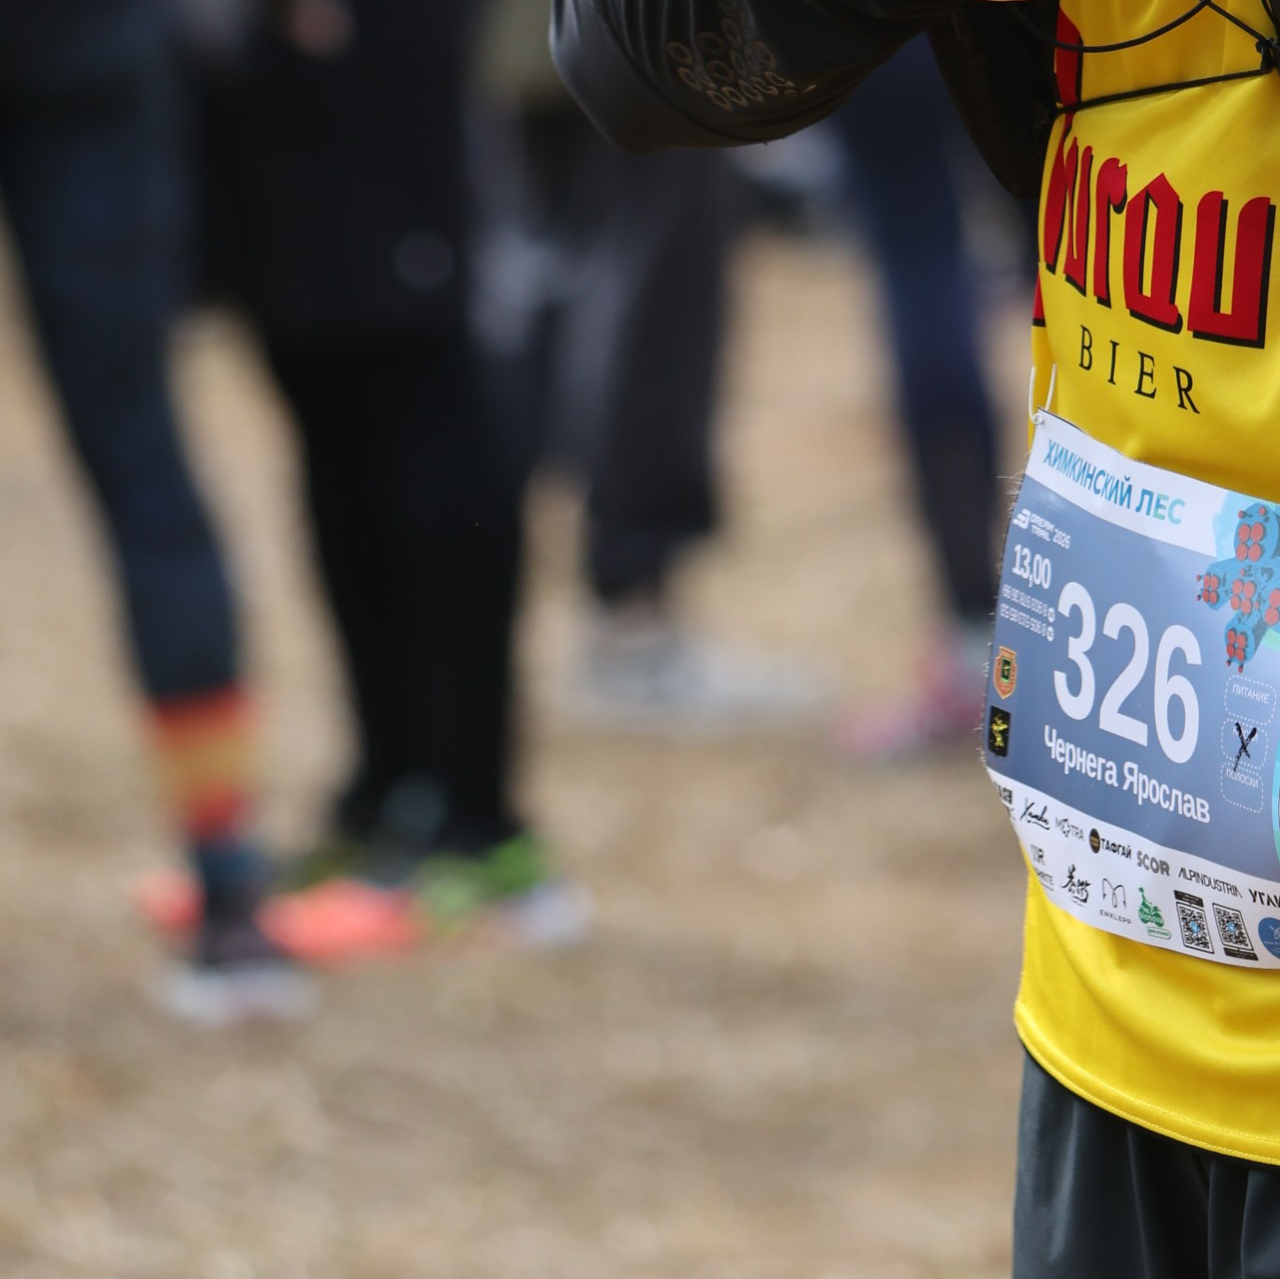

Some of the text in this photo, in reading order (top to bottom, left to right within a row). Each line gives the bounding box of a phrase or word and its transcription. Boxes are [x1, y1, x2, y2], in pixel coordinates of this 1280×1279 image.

[1078, 324, 1200, 415] BIER
[1043, 439, 1186, 526] ХИМКИНСКИЙ ЛЕС
[1012, 544, 1052, 589] 13,00
[1053, 581, 1202, 764] 326
[1232, 684, 1270, 704] ПИТАНИЕ
[1044, 725, 1118, 787] Чернега
[1122, 761, 1211, 824] Ярослав
[1137, 850, 1170, 877] SCOR
